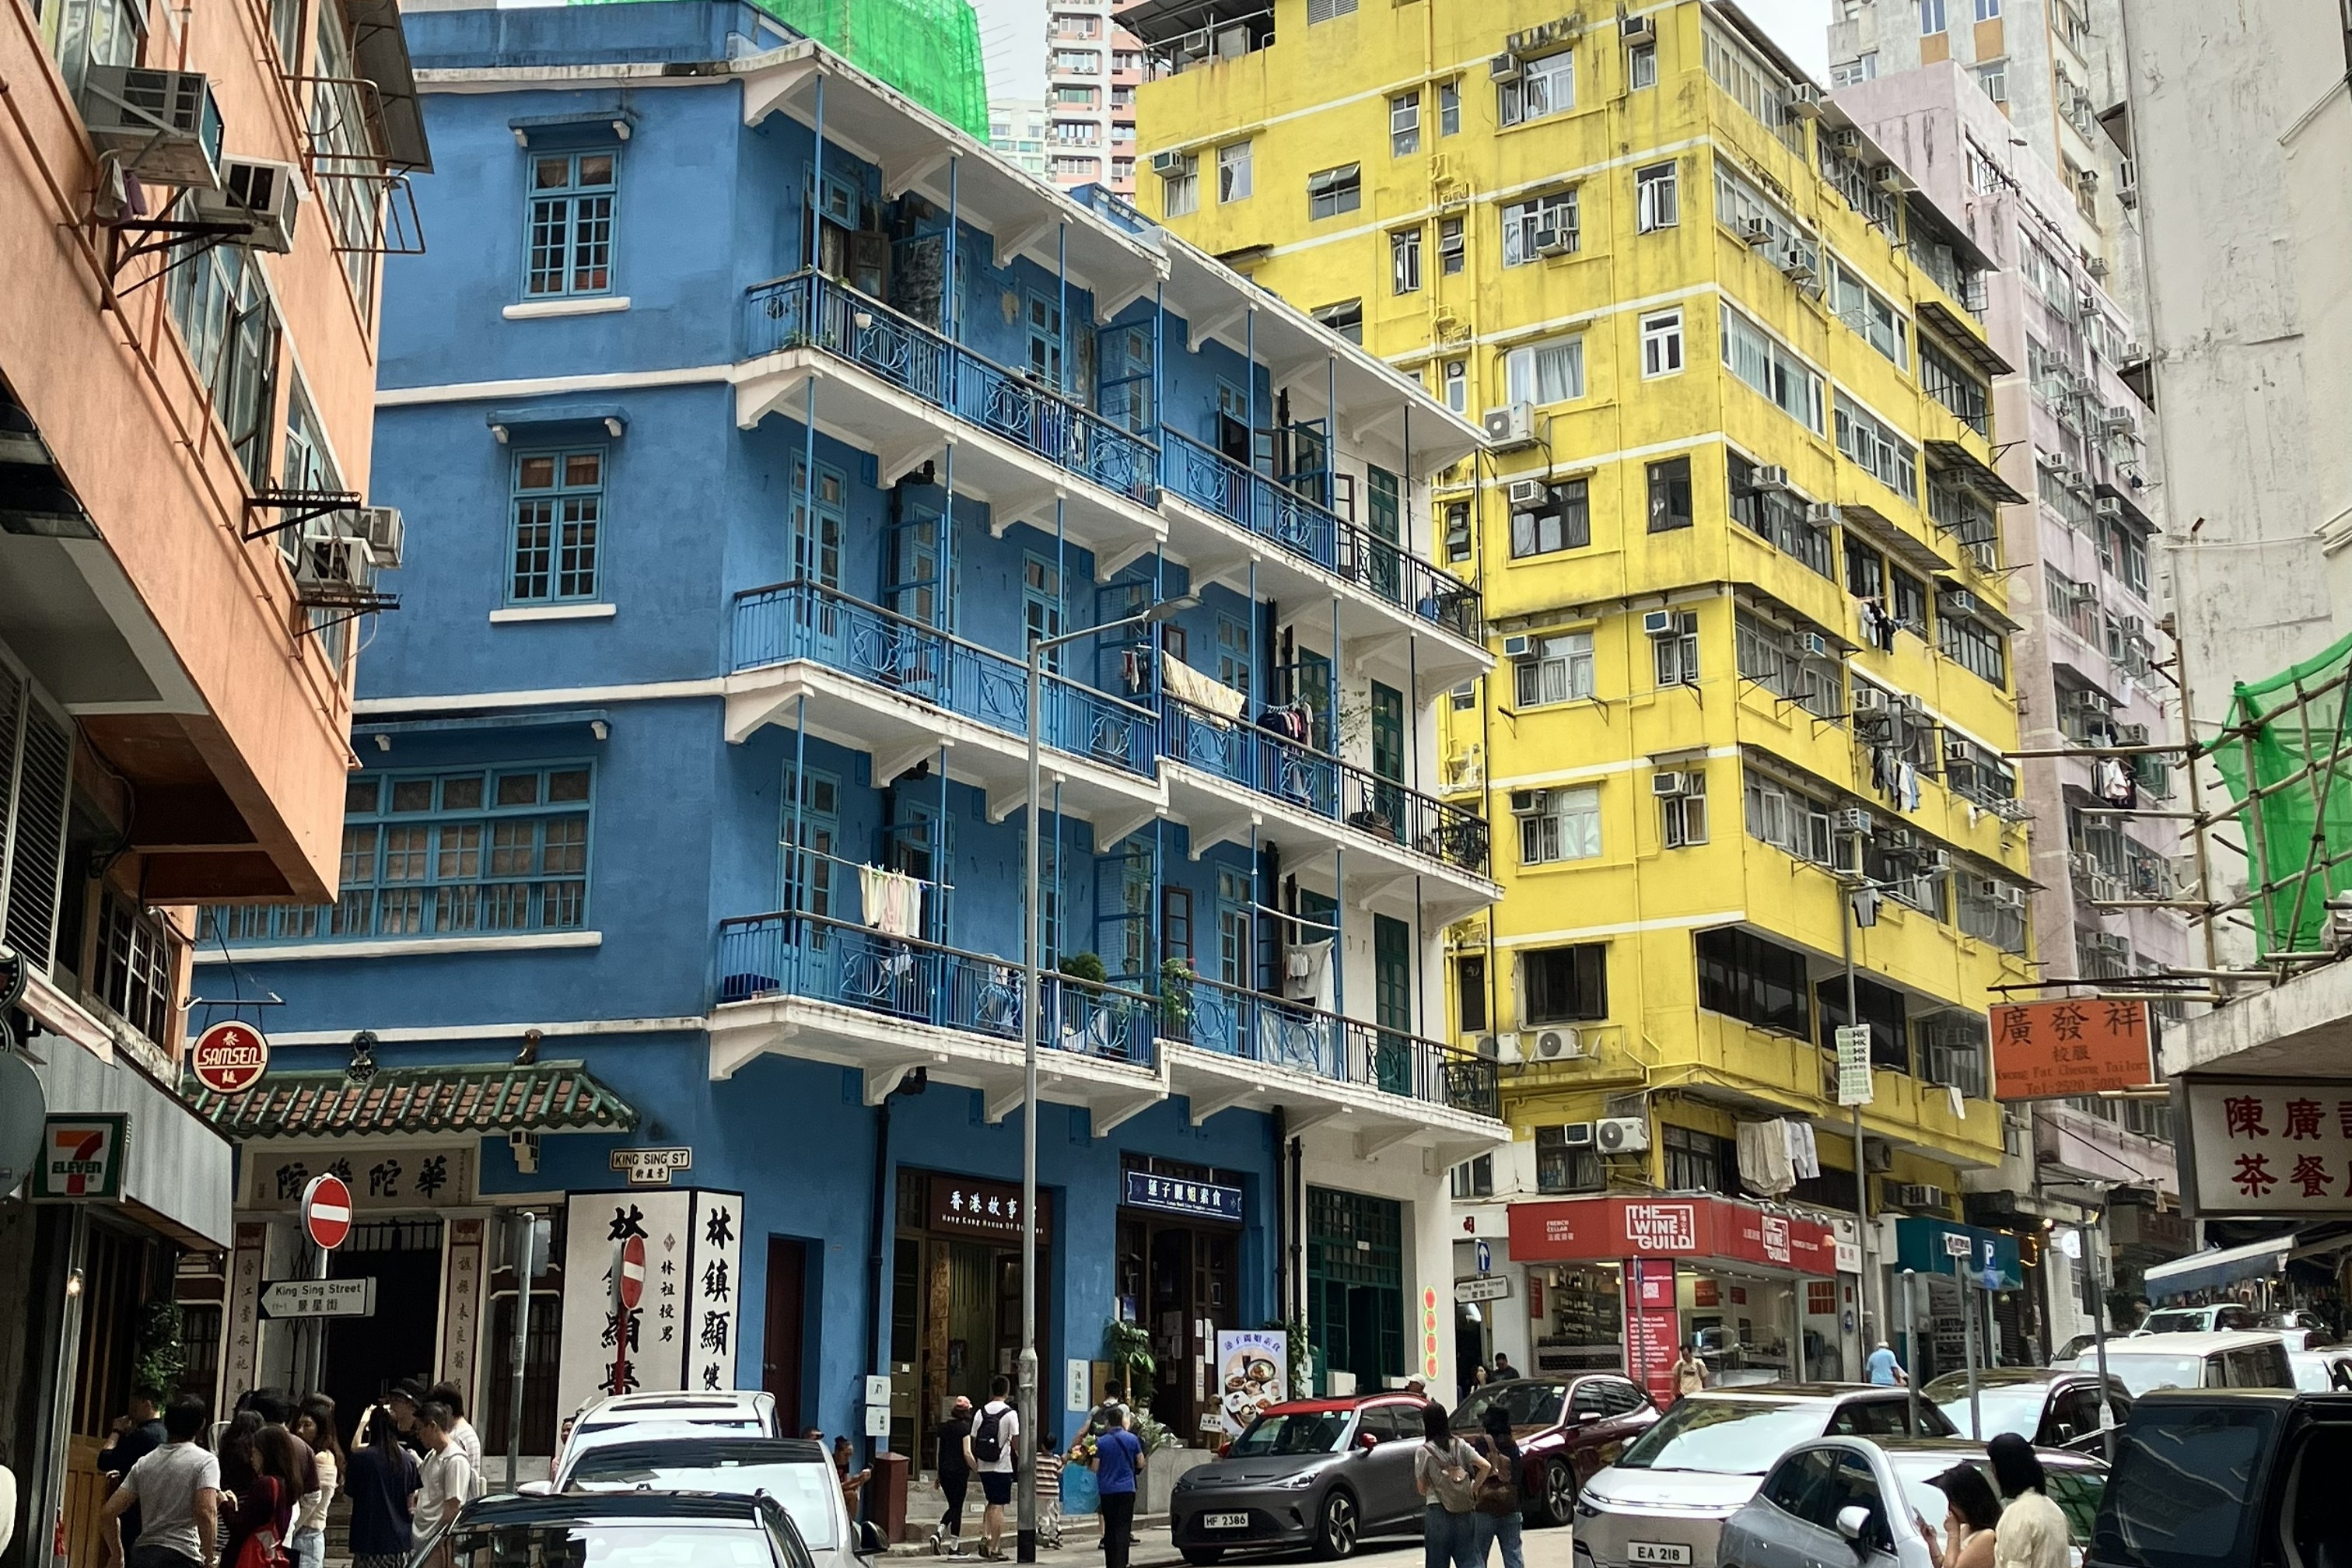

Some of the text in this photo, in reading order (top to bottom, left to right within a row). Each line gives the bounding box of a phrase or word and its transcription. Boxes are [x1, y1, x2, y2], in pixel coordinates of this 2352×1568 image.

[1997, 1002, 2144, 1046] 廣發祥
[198, 1047, 265, 1065] SAMSEN
[2033, 1066, 2053, 1078] Fat
[2058, 1064, 2099, 1076] Cheung
[56, 1131, 103, 1194] 7
[615, 1153, 686, 1166] KING SING ST
[2231, 1153, 2352, 1199] 茶餐
[950, 1190, 1037, 1220] 香港故事
[1633, 1206, 1659, 1219] THE
[1634, 1220, 1678, 1234] WINE
[1638, 1235, 1692, 1249] GUILD
[275, 1284, 361, 1297] King Sing Street
[1206, 1515, 1246, 1526] HF 2386
[1637, 1546, 1680, 1560] EA 218
